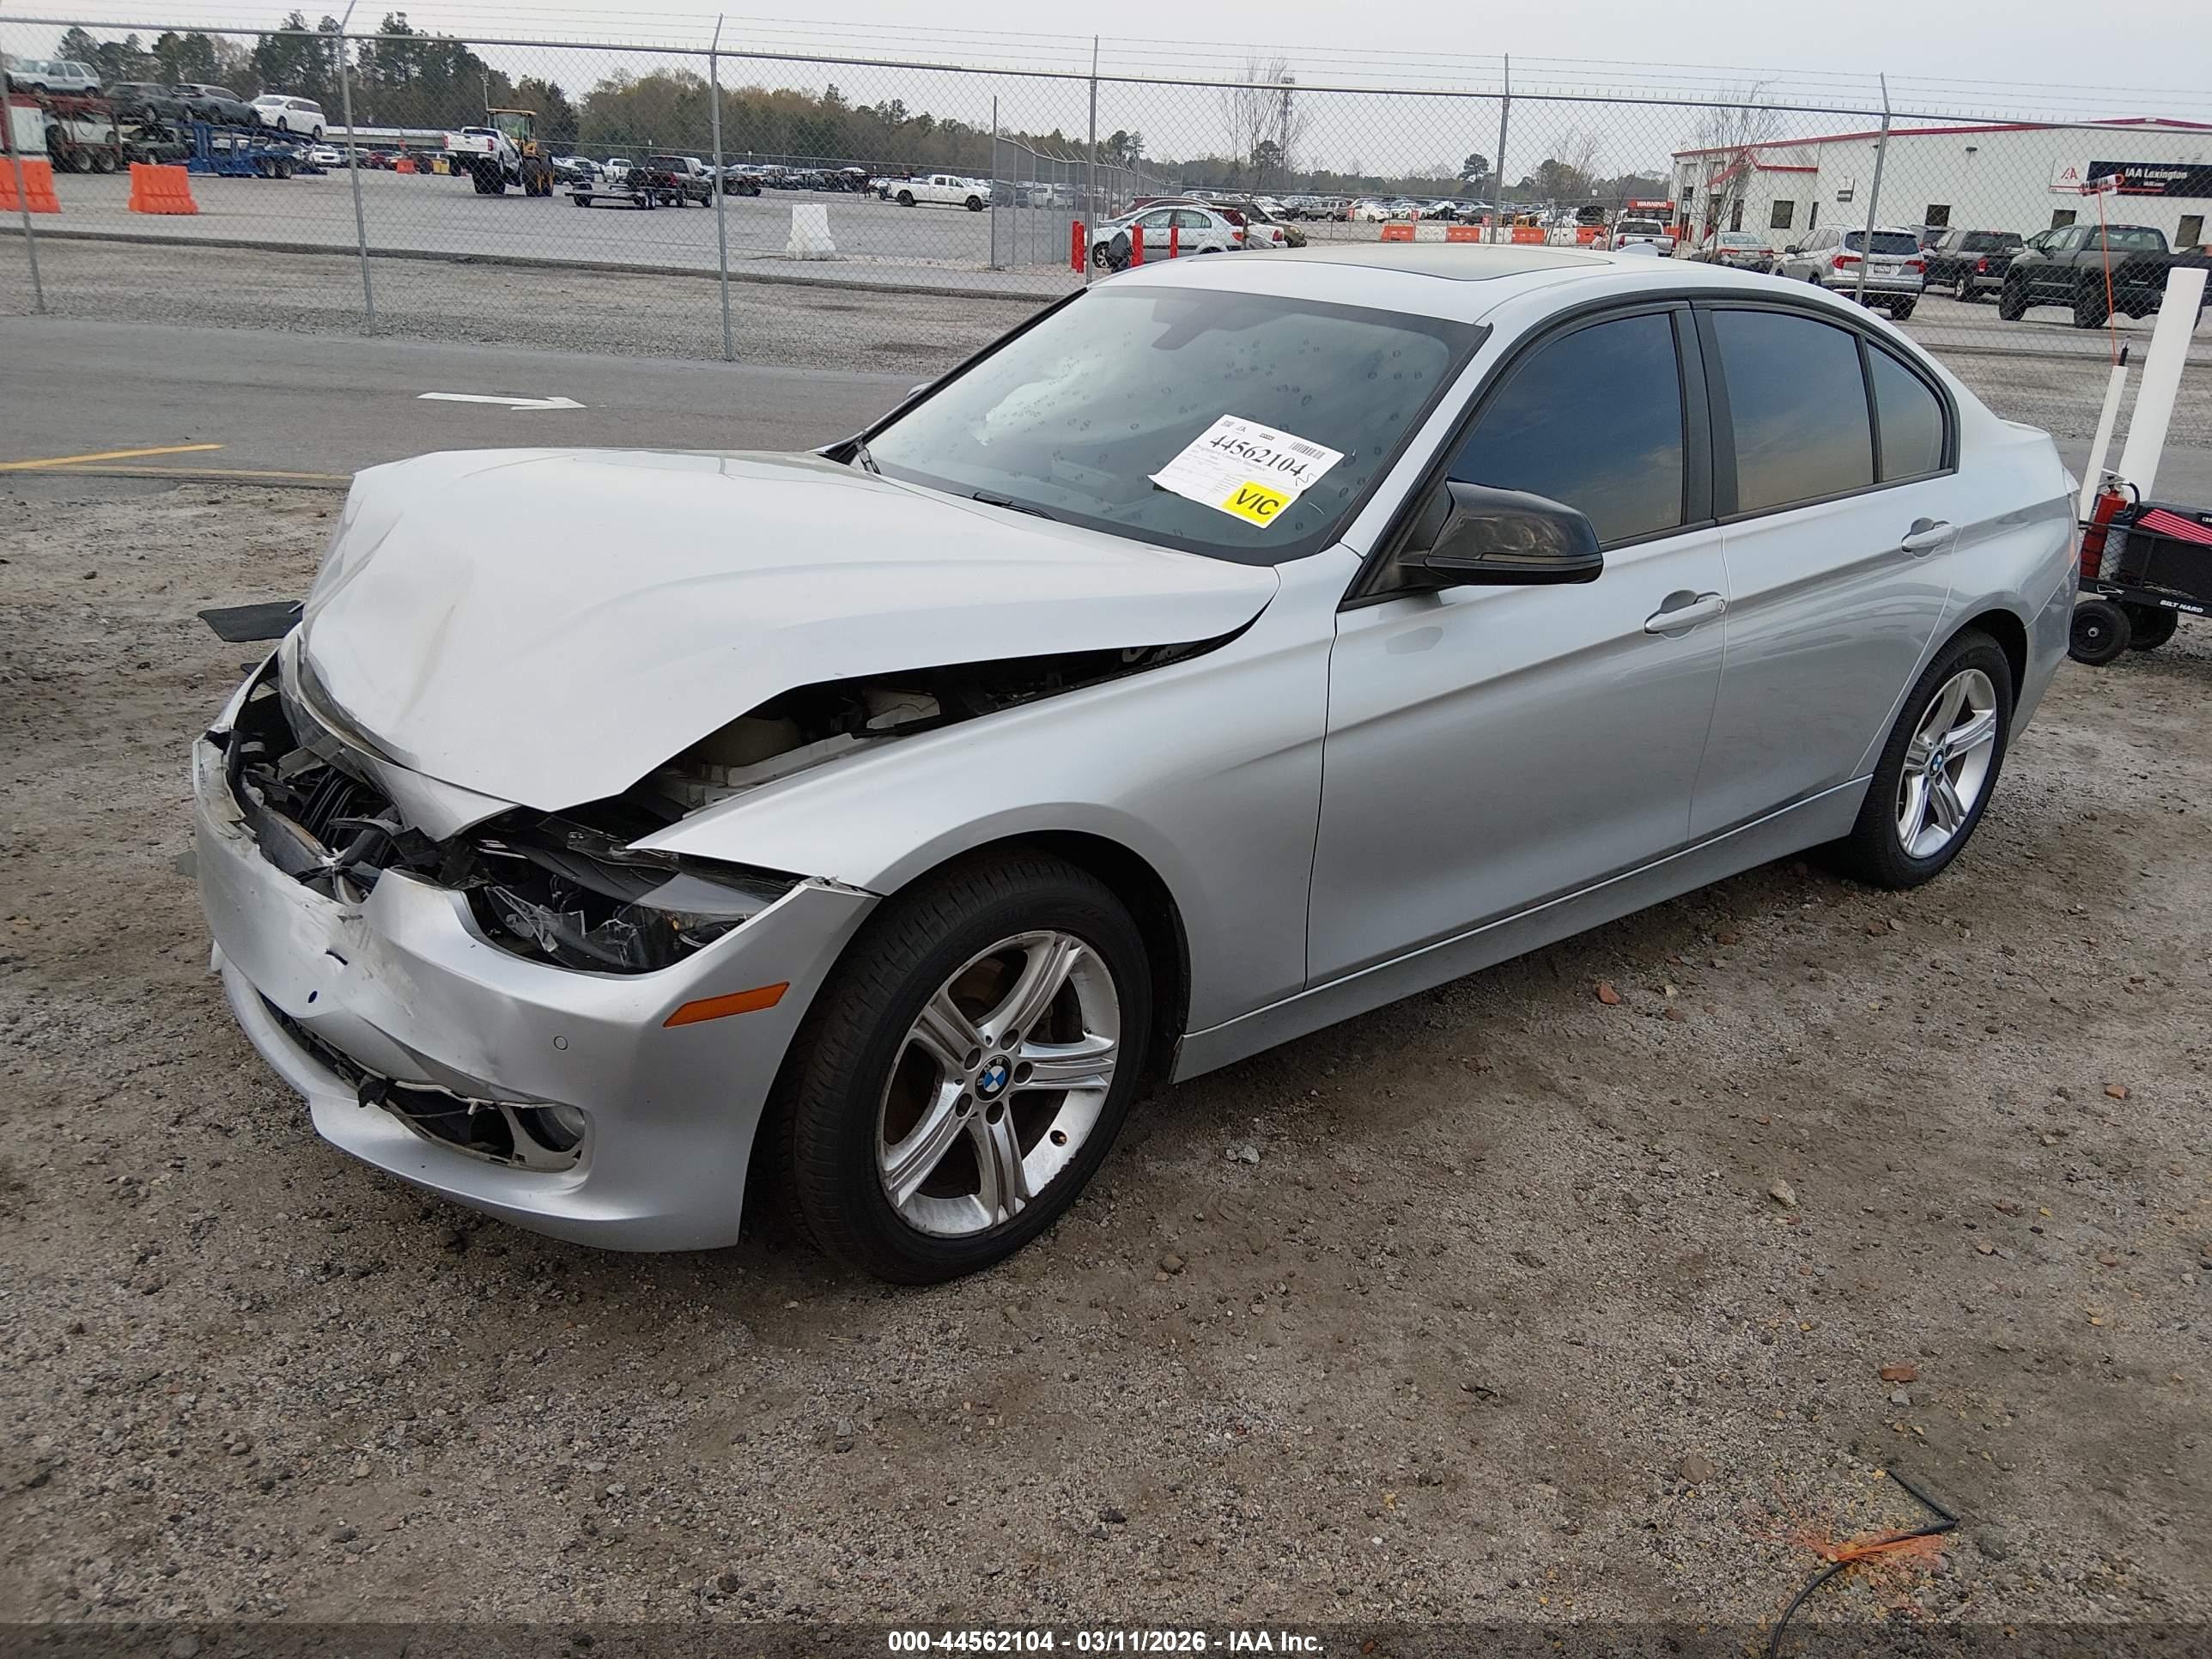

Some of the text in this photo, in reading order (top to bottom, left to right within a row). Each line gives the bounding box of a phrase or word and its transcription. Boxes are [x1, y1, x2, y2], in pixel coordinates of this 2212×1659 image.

[2125, 167, 2188, 180] IAA Lexington
[1210, 434, 1309, 477] 44562104
[1236, 488, 1279, 515] VIC
[2179, 604, 2203, 613] HARD
